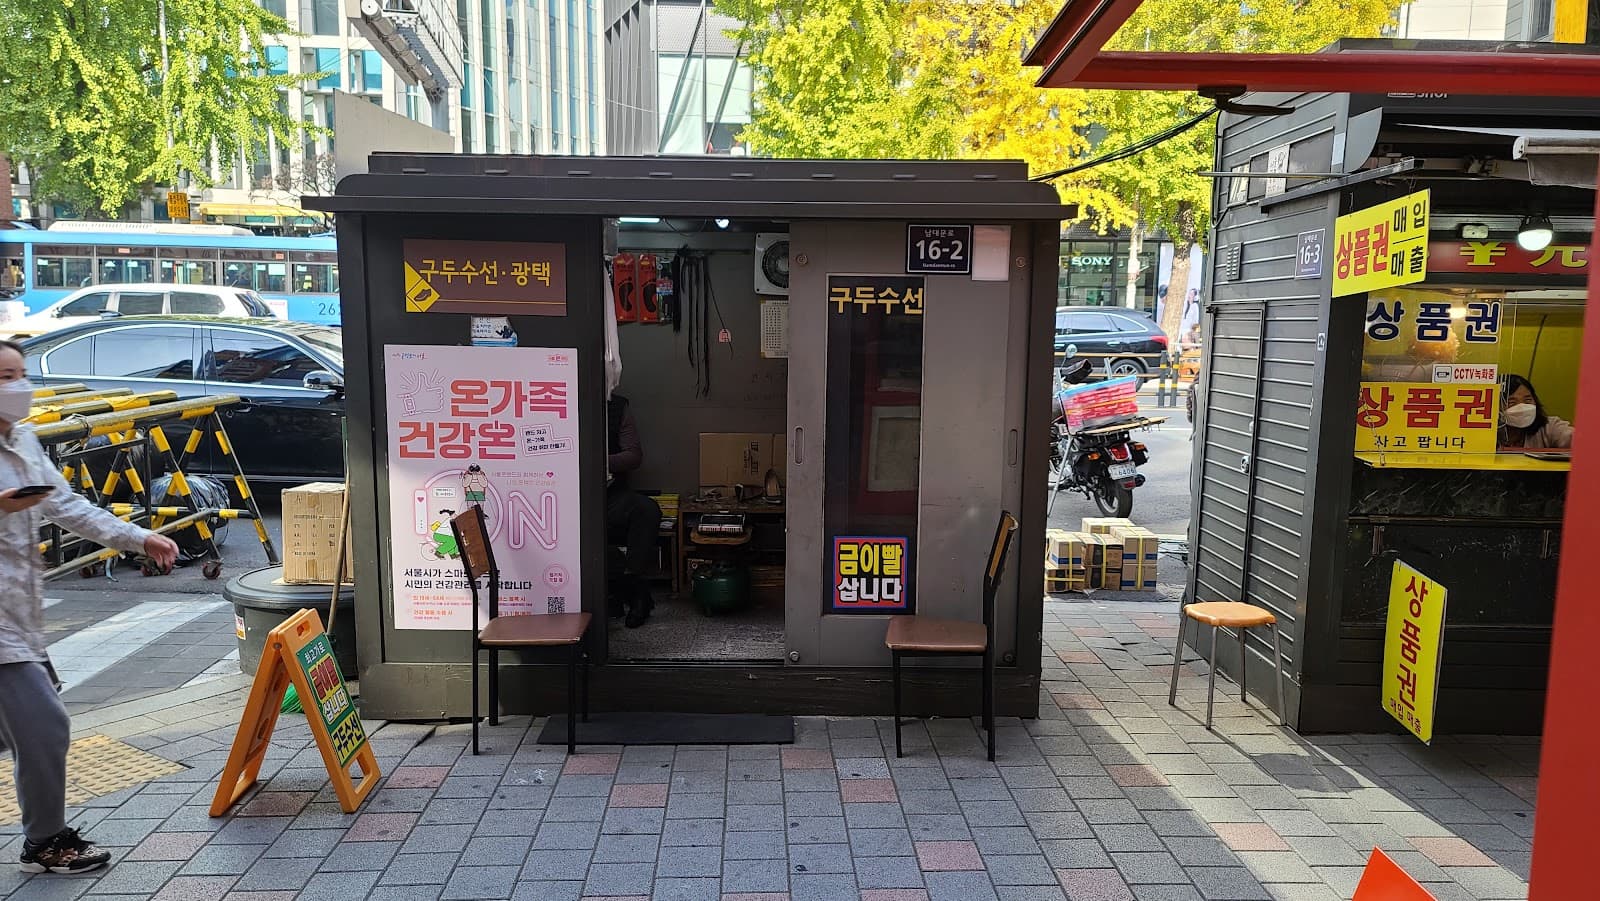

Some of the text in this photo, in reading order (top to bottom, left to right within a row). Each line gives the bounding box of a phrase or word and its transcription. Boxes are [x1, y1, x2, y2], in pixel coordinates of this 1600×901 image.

[925, 229, 954, 238] 남대문로
[1393, 201, 1427, 234] 매입
[916, 240, 963, 260] 16-2
[1071, 256, 1114, 266] SONY
[1300, 243, 1320, 265] 16-3
[1337, 220, 1390, 279] 상품권
[1390, 246, 1424, 278] 매출
[318, 302, 341, 315] 26
[829, 286, 924, 315] 구두수선
[1367, 301, 1500, 343] 상품권
[451, 379, 568, 419] 온가족
[1357, 387, 1494, 429] 상품권
[398, 420, 516, 460] 건강온
[1375, 436, 1466, 449] 사고 팝니다
[404, 568, 442, 578] 서울시가
[839, 543, 903, 576] 금이빨
[405, 580, 432, 589] 시민의
[838, 577, 903, 602] 삽니다
[1396, 575, 1429, 711] 상품권
[323, 688, 349, 722] 삽니다
[332, 713, 363, 759] 구두수선
